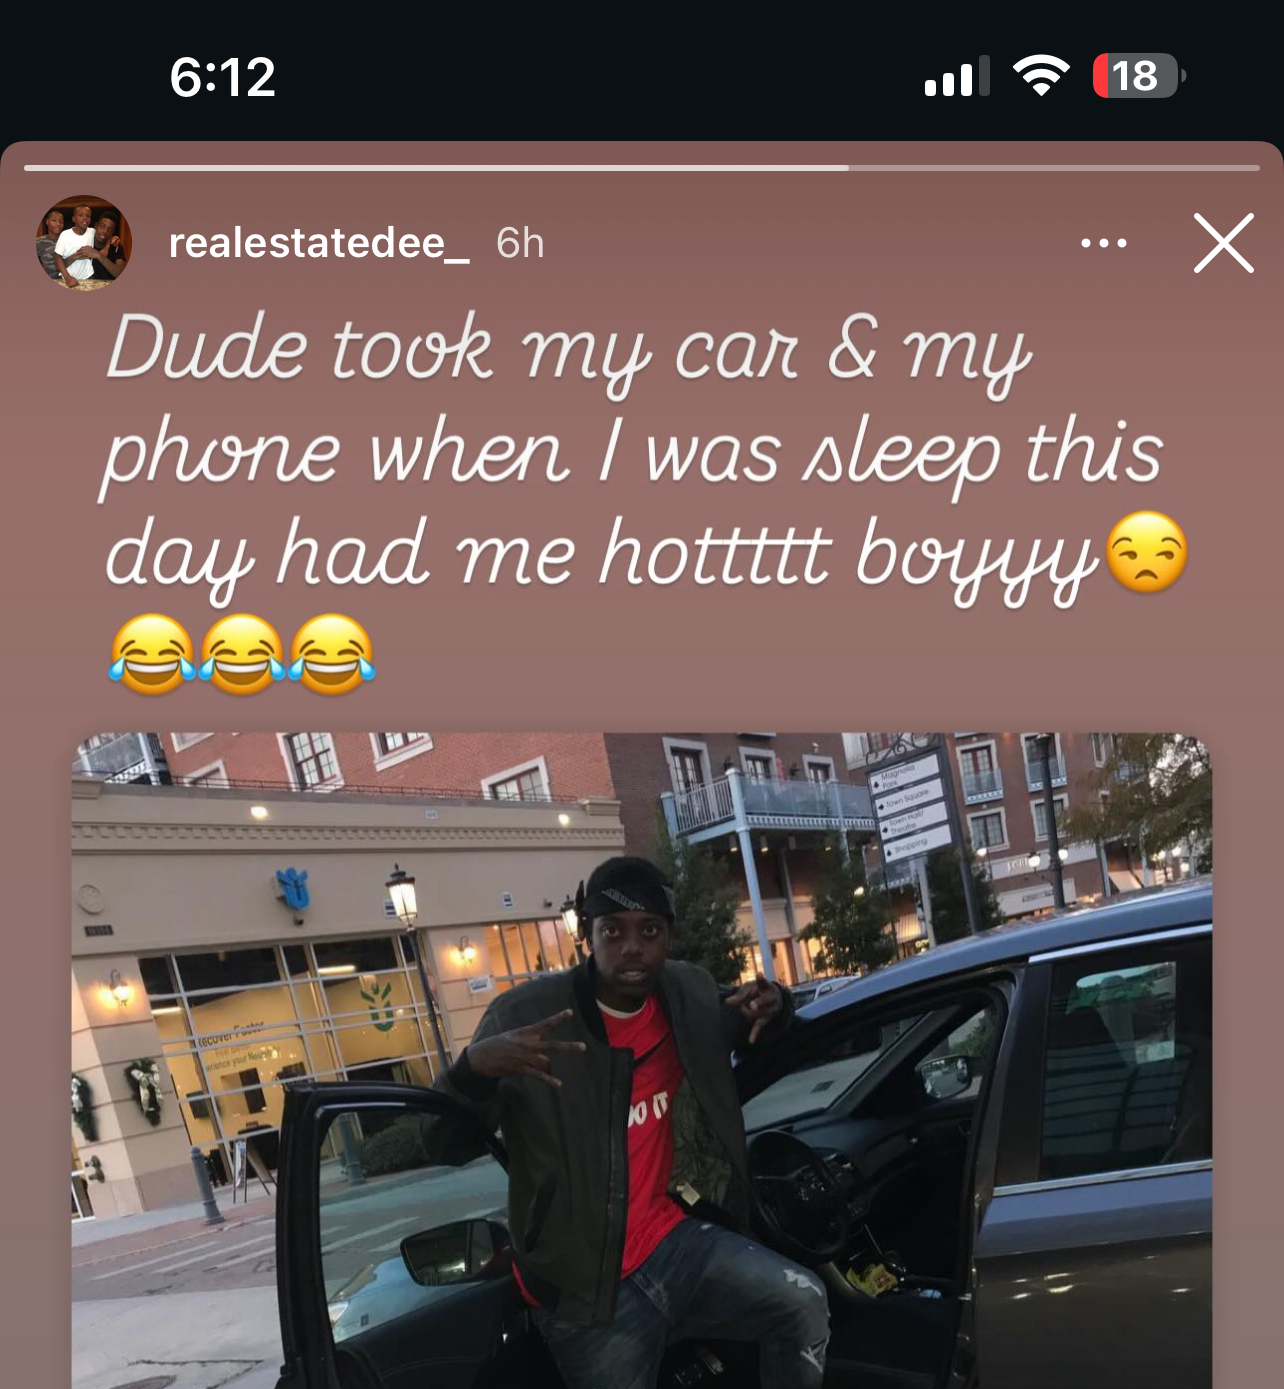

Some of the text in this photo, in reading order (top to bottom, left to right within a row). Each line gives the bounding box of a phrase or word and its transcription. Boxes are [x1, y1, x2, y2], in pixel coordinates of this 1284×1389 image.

[881, 764, 915, 780] Magnolia
[882, 780, 898, 789] Park
[886, 789, 929, 808] Town Square
[889, 816, 907, 827] Town
[895, 838, 928, 853] Shopping
